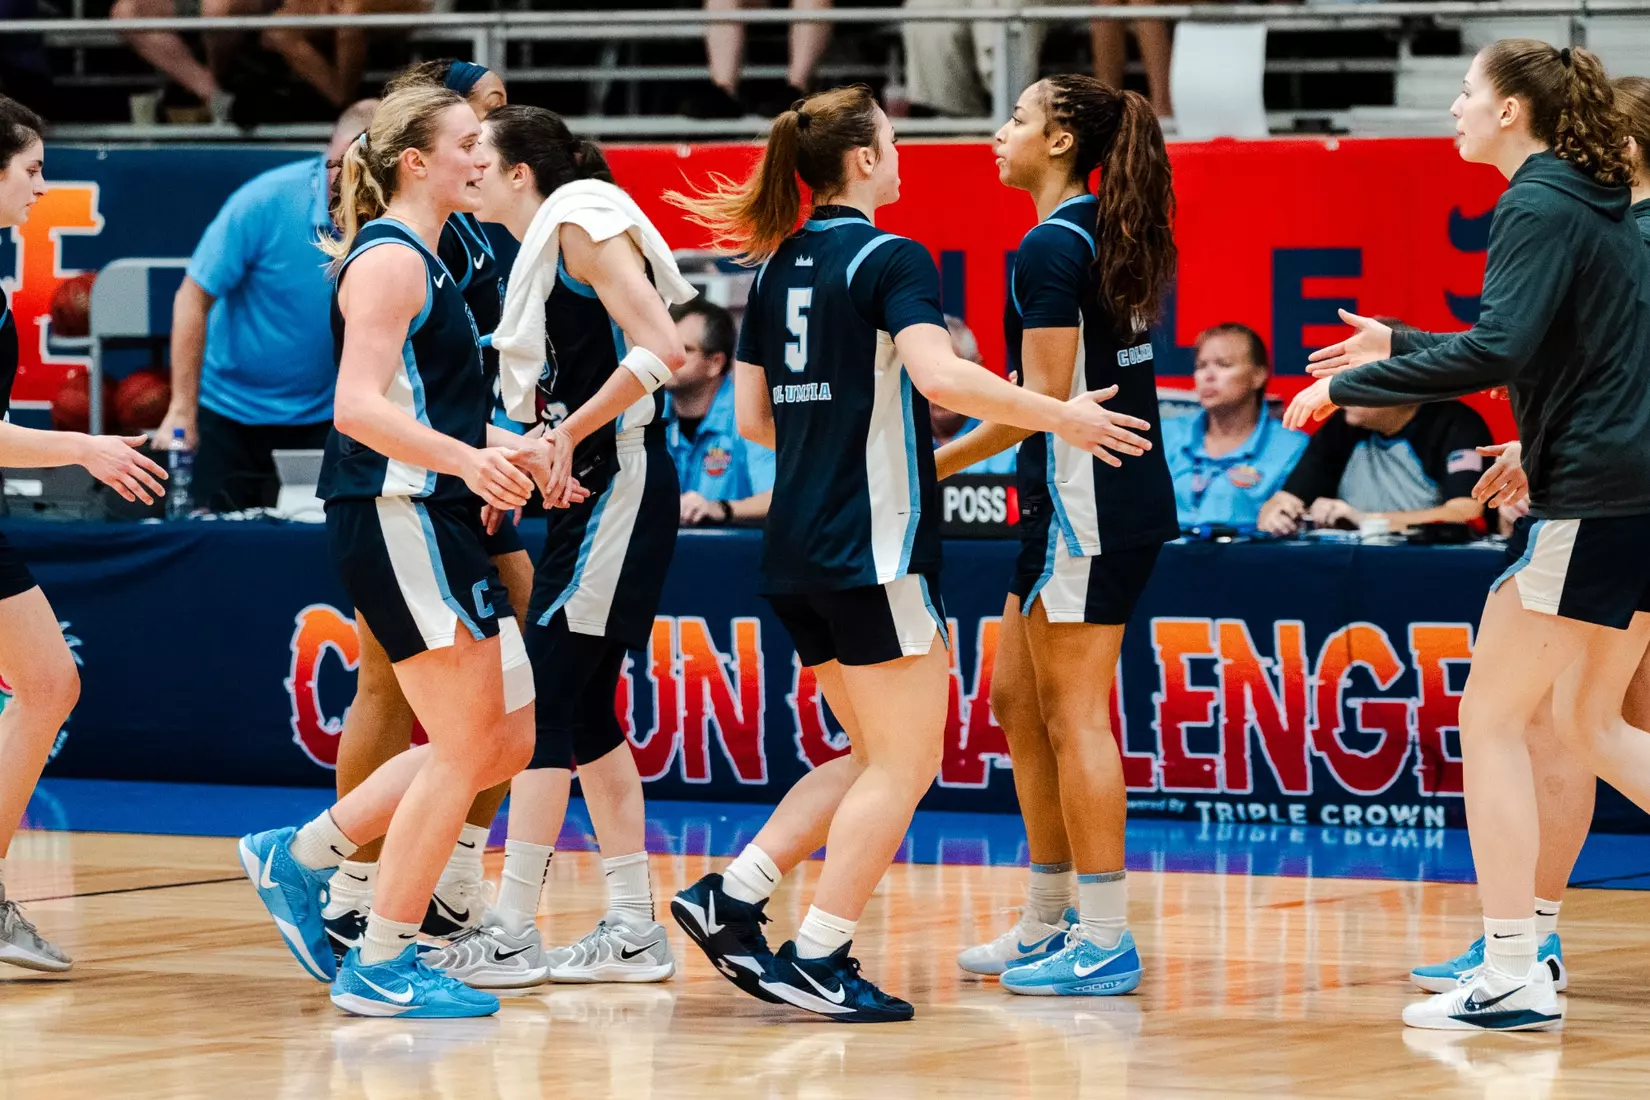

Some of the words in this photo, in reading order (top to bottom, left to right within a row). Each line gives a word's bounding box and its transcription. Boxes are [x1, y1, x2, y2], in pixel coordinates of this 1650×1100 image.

[784, 286, 813, 373] 5
[943, 485, 1007, 523] POSS
[471, 579, 495, 618] C
[1194, 801, 1307, 824] TRIPLE
[1320, 804, 1446, 828] CROWN
